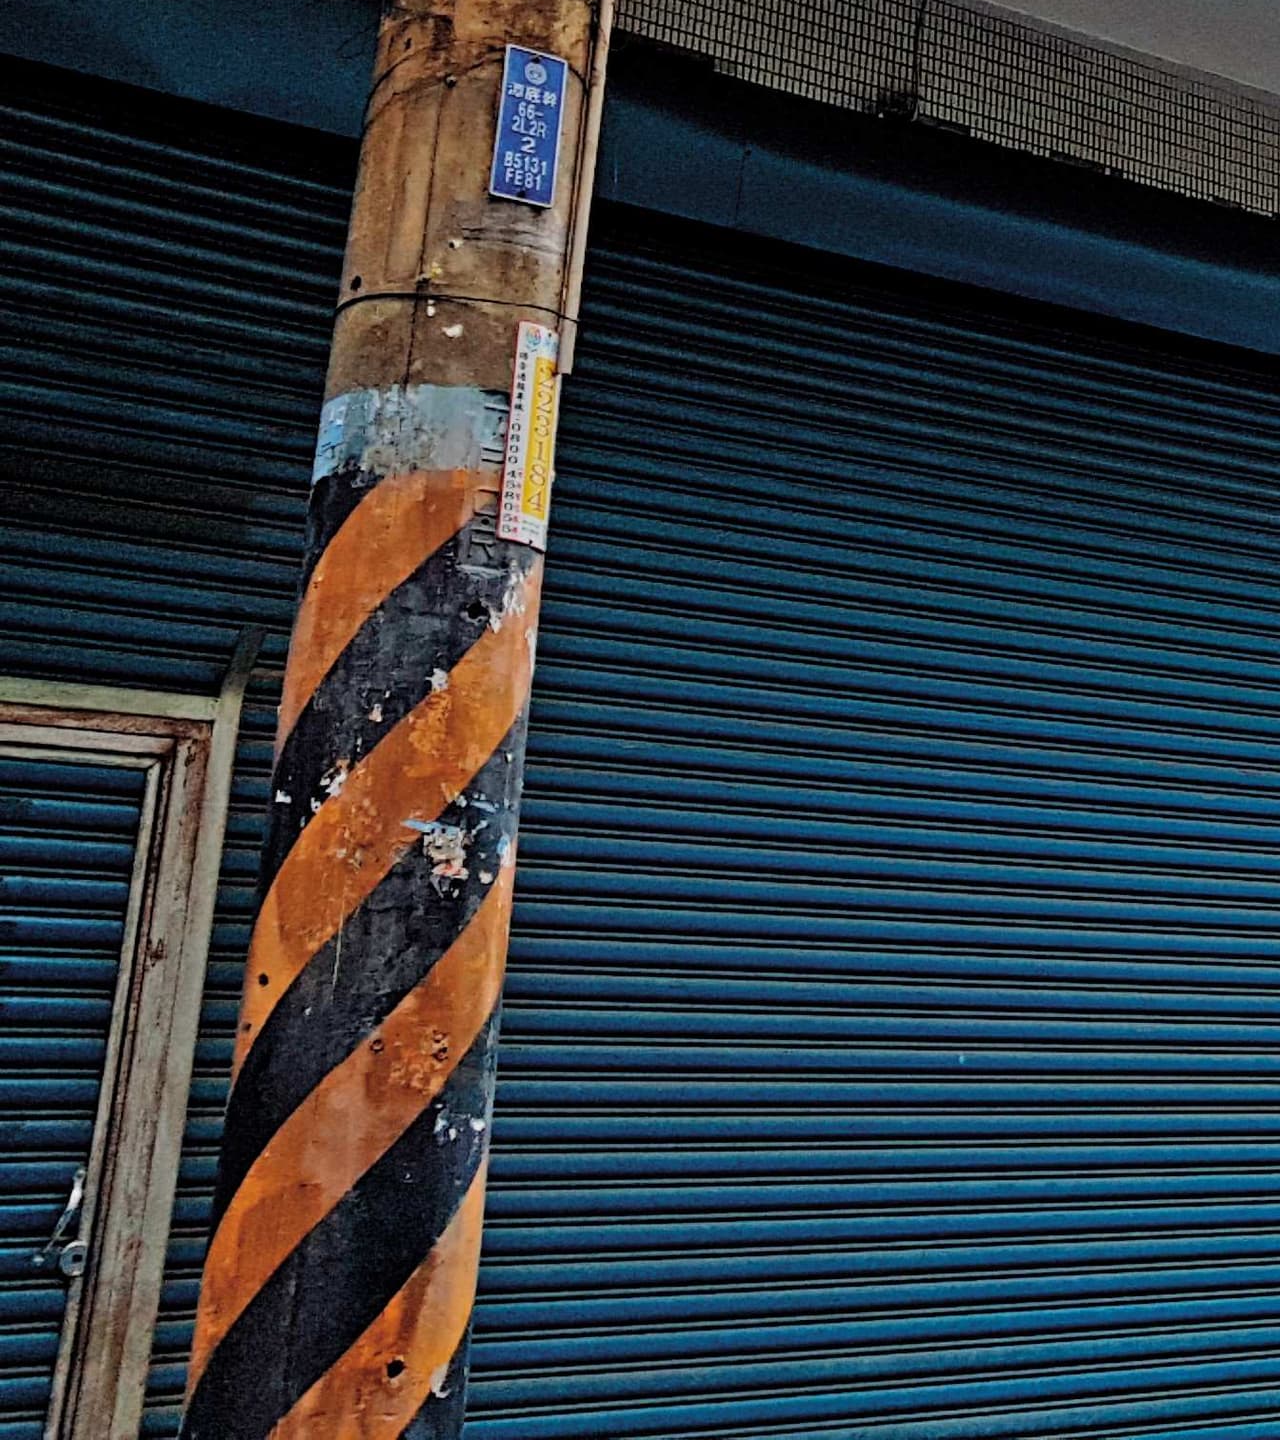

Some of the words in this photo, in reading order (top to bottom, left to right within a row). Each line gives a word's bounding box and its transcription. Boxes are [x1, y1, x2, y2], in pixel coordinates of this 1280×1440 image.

[518, 101, 544, 120] 66-
[520, 136, 536, 153] 2
[503, 151, 547, 176] B5131
[505, 168, 541, 191] FE81
